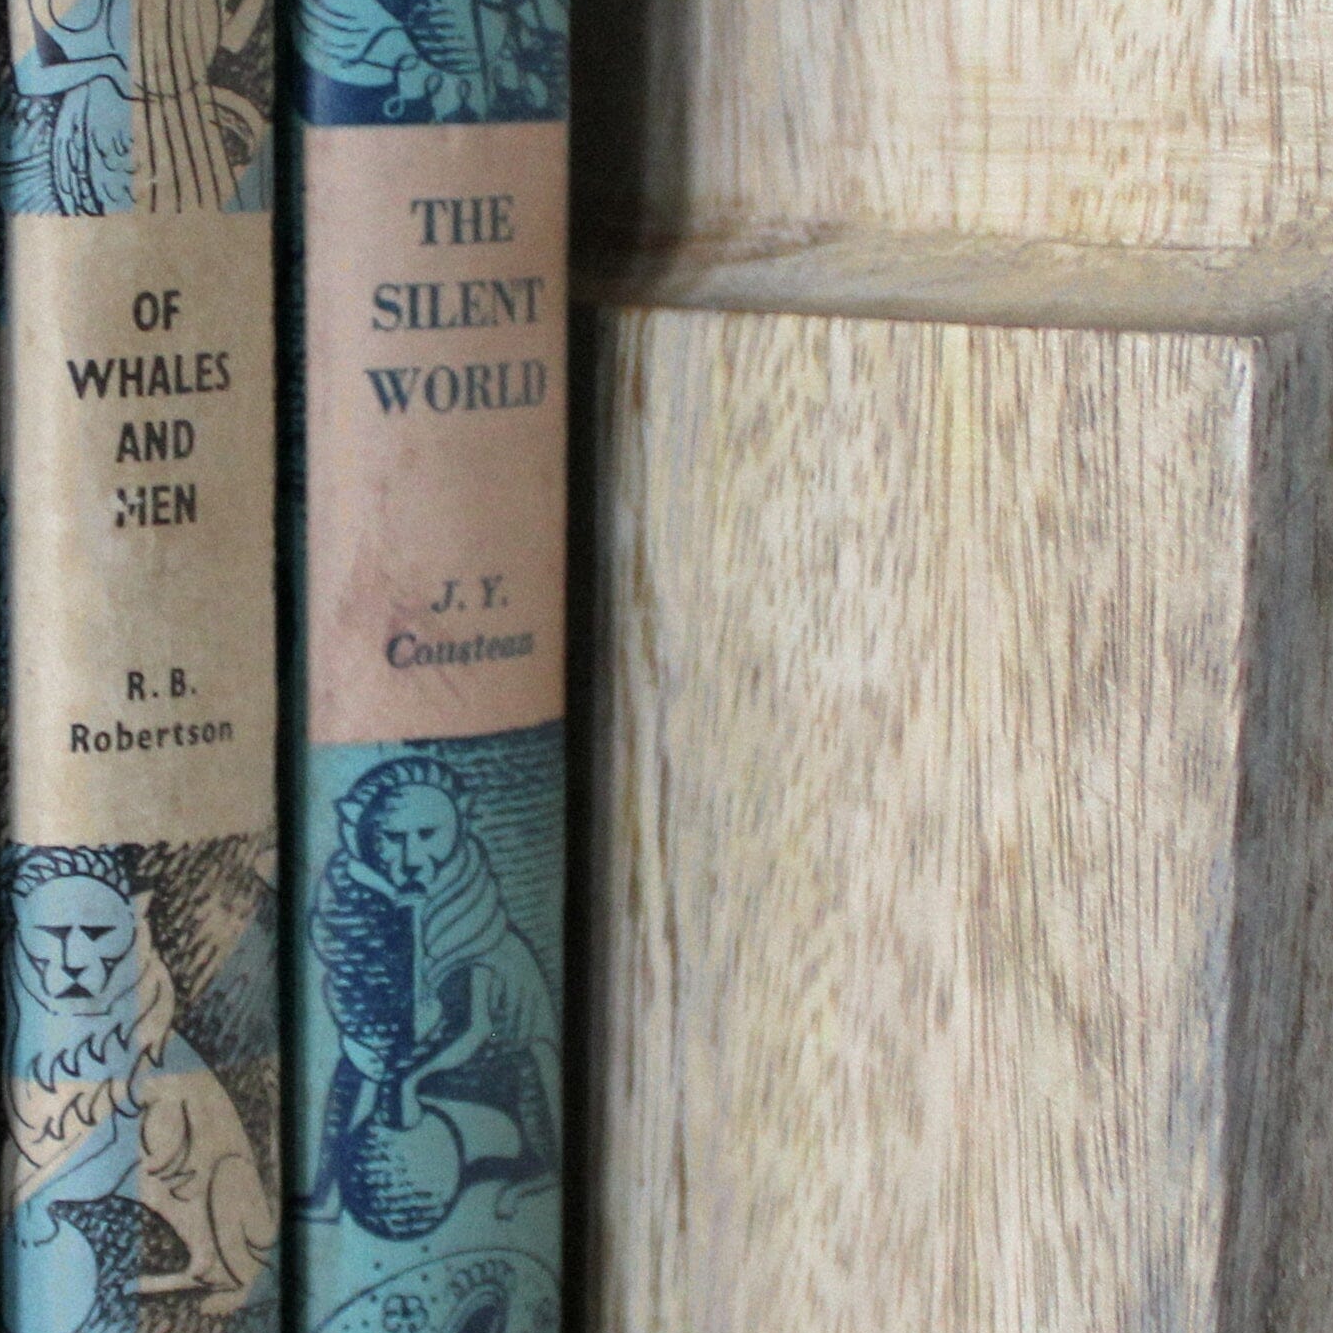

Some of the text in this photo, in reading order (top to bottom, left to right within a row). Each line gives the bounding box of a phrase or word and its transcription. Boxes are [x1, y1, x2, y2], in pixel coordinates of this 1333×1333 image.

[411, 194, 514, 246] THE
[133, 290, 181, 332] OF
[372, 276, 545, 332] SILENT
[66, 352, 231, 399] WHALES
[364, 359, 547, 415] WORLD
[117, 419, 195, 463] AND
[115, 483, 198, 529] MEN
[430, 575, 508, 615] J. Y.
[126, 668, 198, 701] R. B.
[70, 719, 234, 754] Robertson
